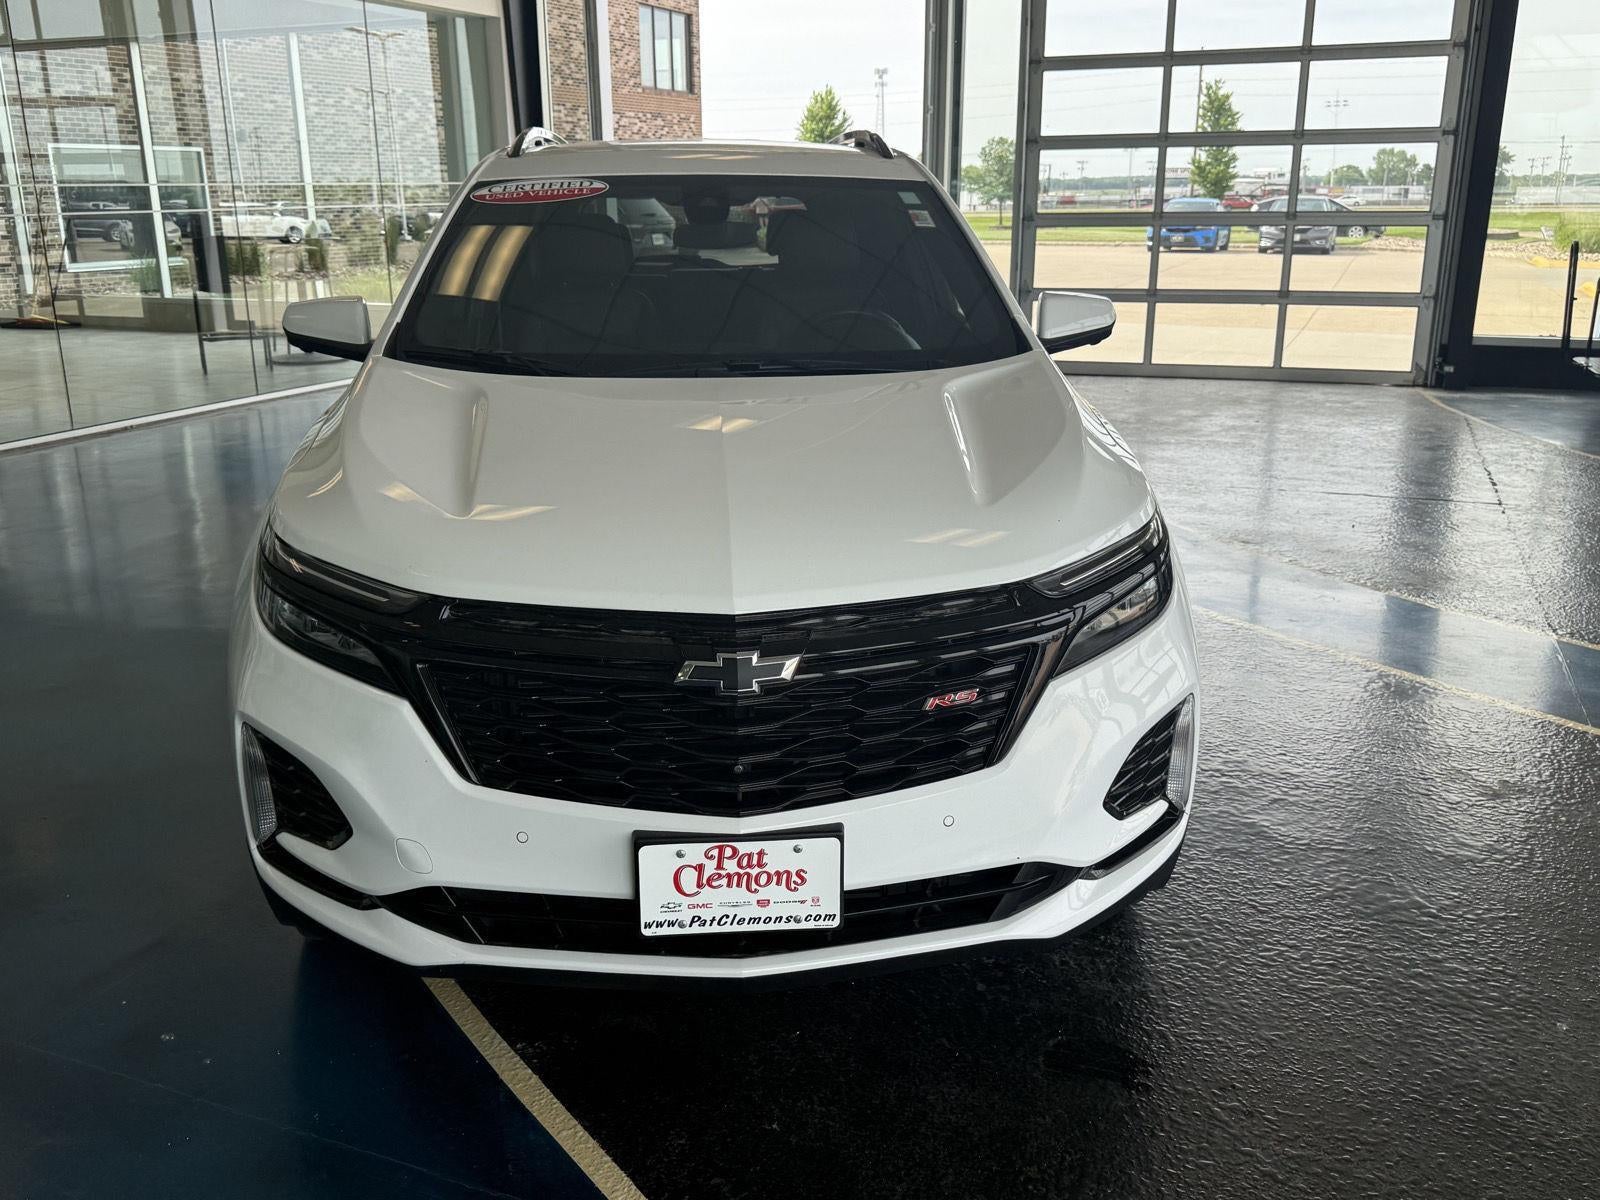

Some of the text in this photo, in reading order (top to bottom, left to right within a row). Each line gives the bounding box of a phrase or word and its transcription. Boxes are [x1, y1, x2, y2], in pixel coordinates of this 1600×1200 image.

[485, 187, 592, 200] USED VEHICLE
[488, 181, 594, 193] CERTIFIED
[922, 688, 979, 710] RS
[704, 844, 768, 871] Pat
[673, 863, 808, 898] Clemons
[643, 913, 836, 930] wwwPatClemonscom
